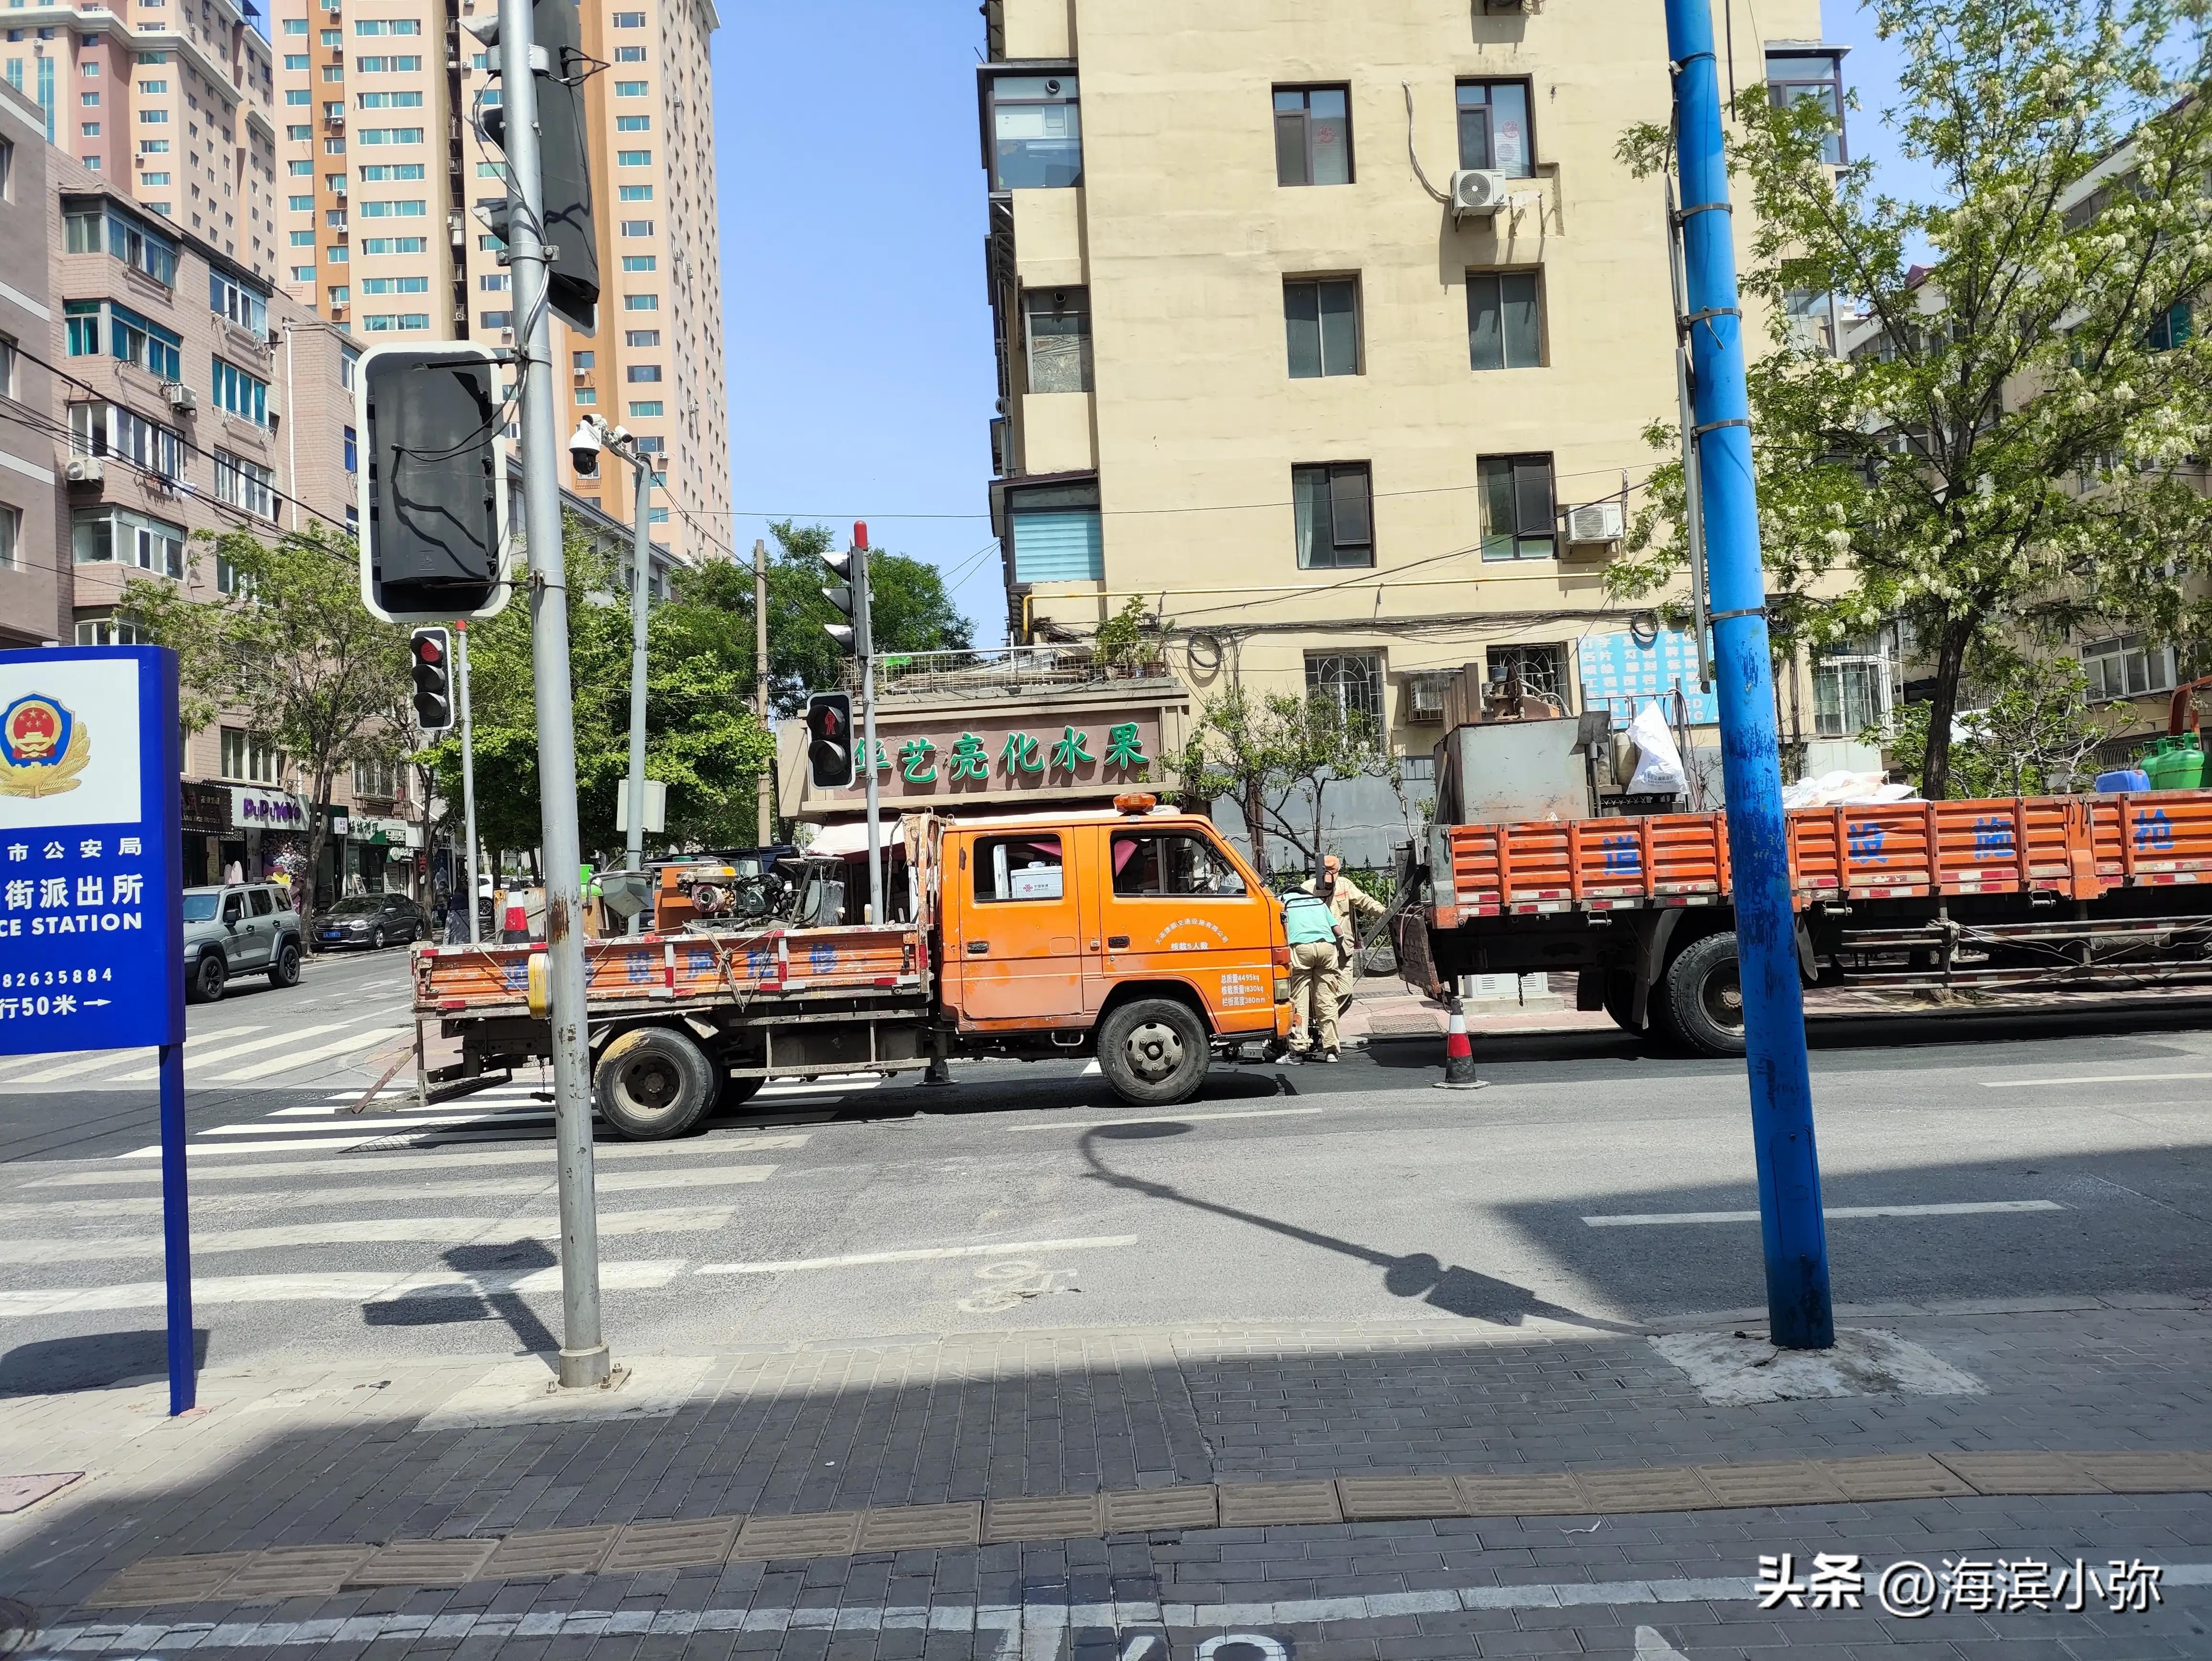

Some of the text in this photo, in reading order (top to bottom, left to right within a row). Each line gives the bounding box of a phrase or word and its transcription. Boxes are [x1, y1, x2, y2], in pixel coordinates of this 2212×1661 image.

[7, 837, 142, 862] 市公安局
[4, 873, 144, 911] 街派出所
[31, 912, 142, 935] STATION
[1171, 941, 1208, 950] 核载5人数
[2, 967, 112, 988] 82635884
[1221, 974, 1260, 984] 总质量4495kg
[0, 994, 77, 1019] 行50米
[1222, 997, 1266, 1007] 栏板高度380mm
